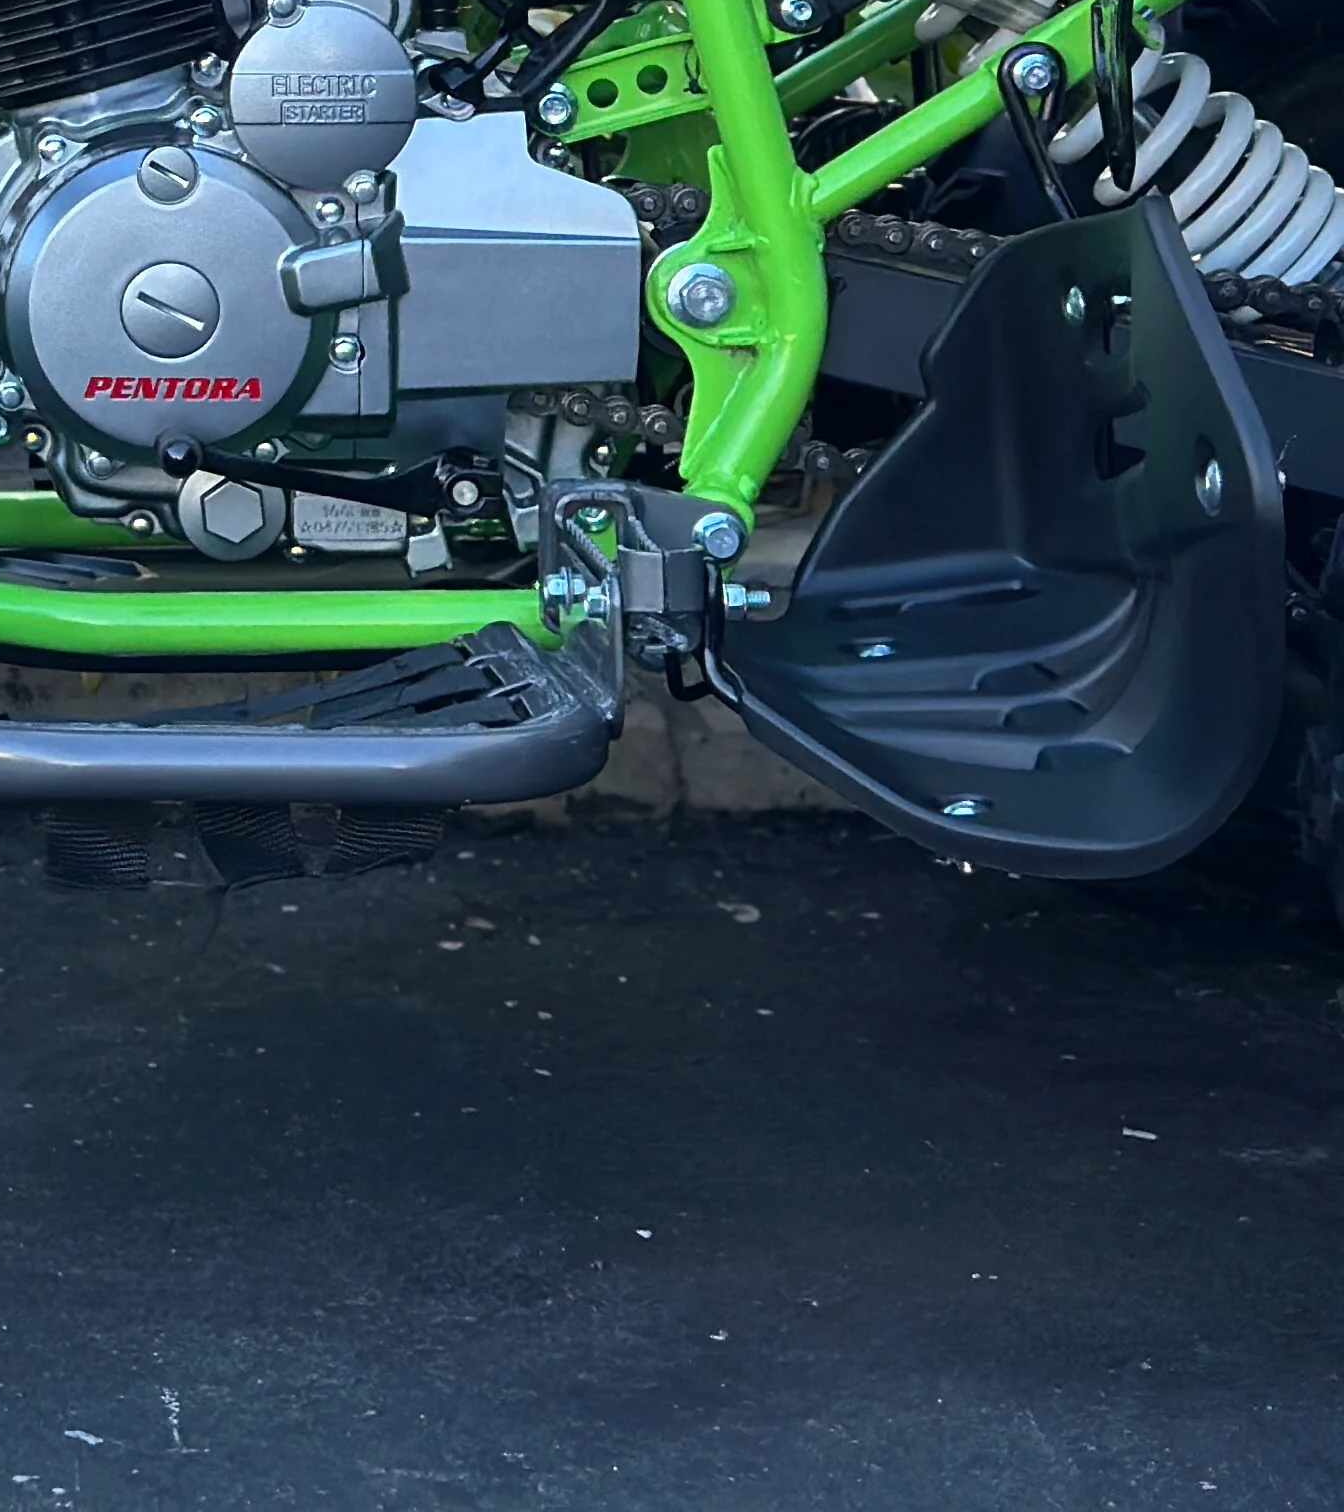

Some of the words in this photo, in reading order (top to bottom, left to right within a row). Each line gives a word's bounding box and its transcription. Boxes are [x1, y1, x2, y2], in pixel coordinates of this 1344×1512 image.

[271, 74, 378, 98] ELECTRIC
[285, 104, 363, 121] STARTER
[83, 375, 263, 402] PENTORA
